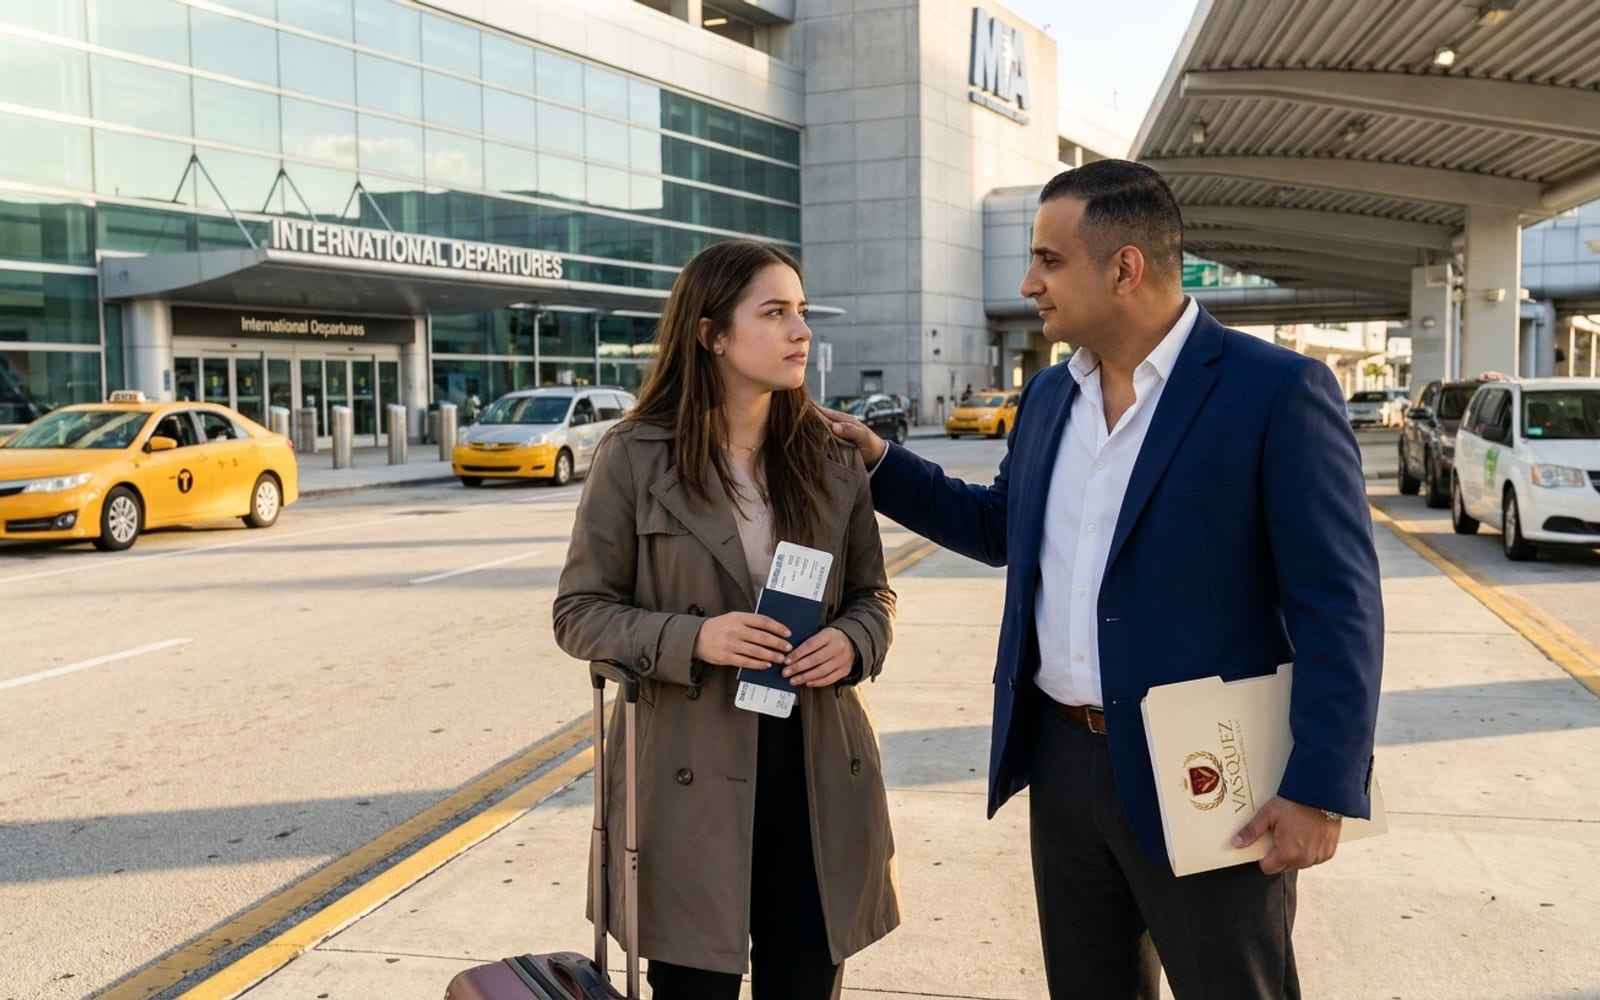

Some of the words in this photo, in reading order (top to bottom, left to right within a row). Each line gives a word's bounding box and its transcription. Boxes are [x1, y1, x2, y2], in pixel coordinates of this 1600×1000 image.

[273, 219, 448, 267] INTERNATIONAL
[451, 241, 563, 279] DEPARTURES
[241, 316, 308, 333] International
[310, 320, 365, 338] Departures
[1218, 719, 1247, 813] VASQUEZ
